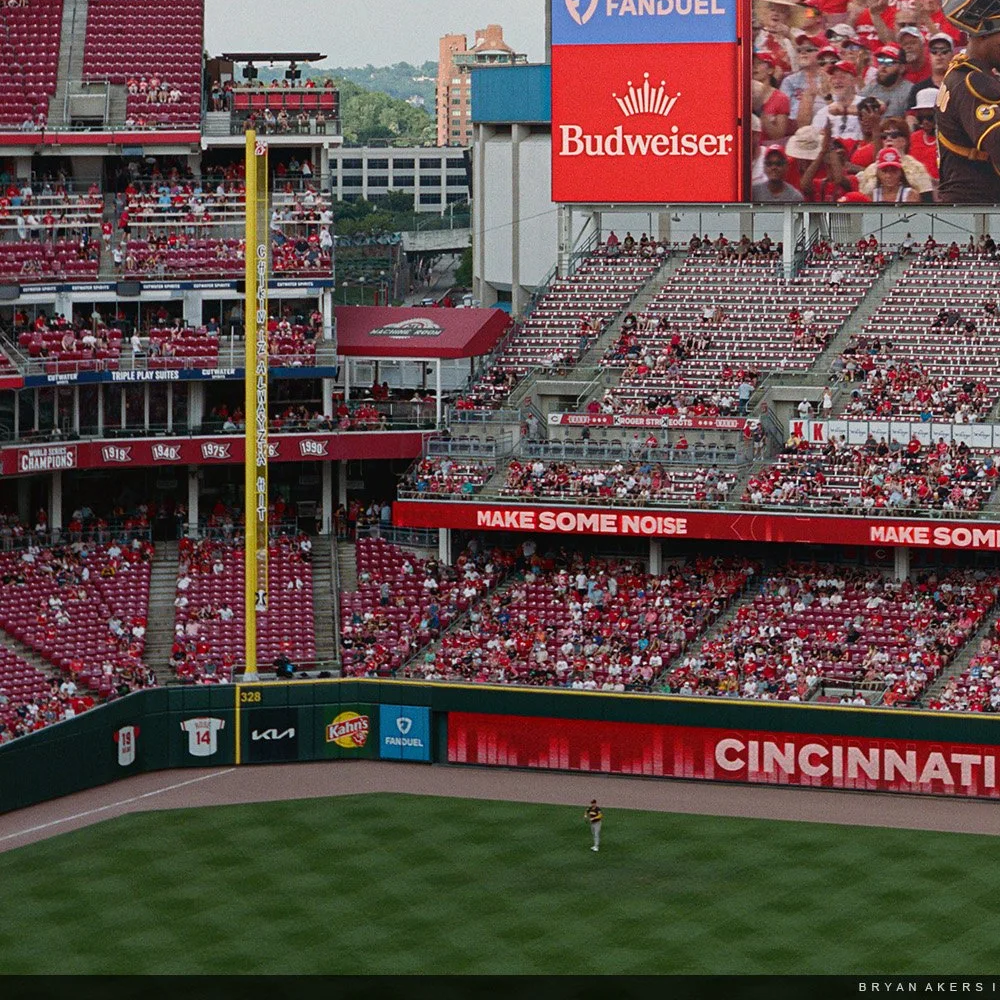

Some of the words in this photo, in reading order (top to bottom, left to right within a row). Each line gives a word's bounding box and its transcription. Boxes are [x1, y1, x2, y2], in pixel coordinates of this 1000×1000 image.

[559, 125, 732, 157] Budweiser
[112, 371, 135, 381] TRIPLE
[136, 370, 154, 381] PLAY
[155, 370, 180, 380] SUITES
[813, 423, 823, 441] K
[104, 446, 125, 460] 1919
[153, 444, 175, 459] 1940
[203, 443, 225, 458] 1975
[301, 441, 323, 454] 1990
[21, 451, 73, 471] CHAMPIONS
[477, 510, 536, 529] MAKE
[538, 511, 618, 532] SOME
[621, 514, 687, 534] NOISE
[870, 526, 930, 545] MAKE
[240, 691, 262, 702] 328
[328, 718, 369, 739] Kahn's
[196, 731, 211, 745] 14
[385, 736, 424, 747] FANDUEL
[714, 738, 996, 788] CINCINNATI
